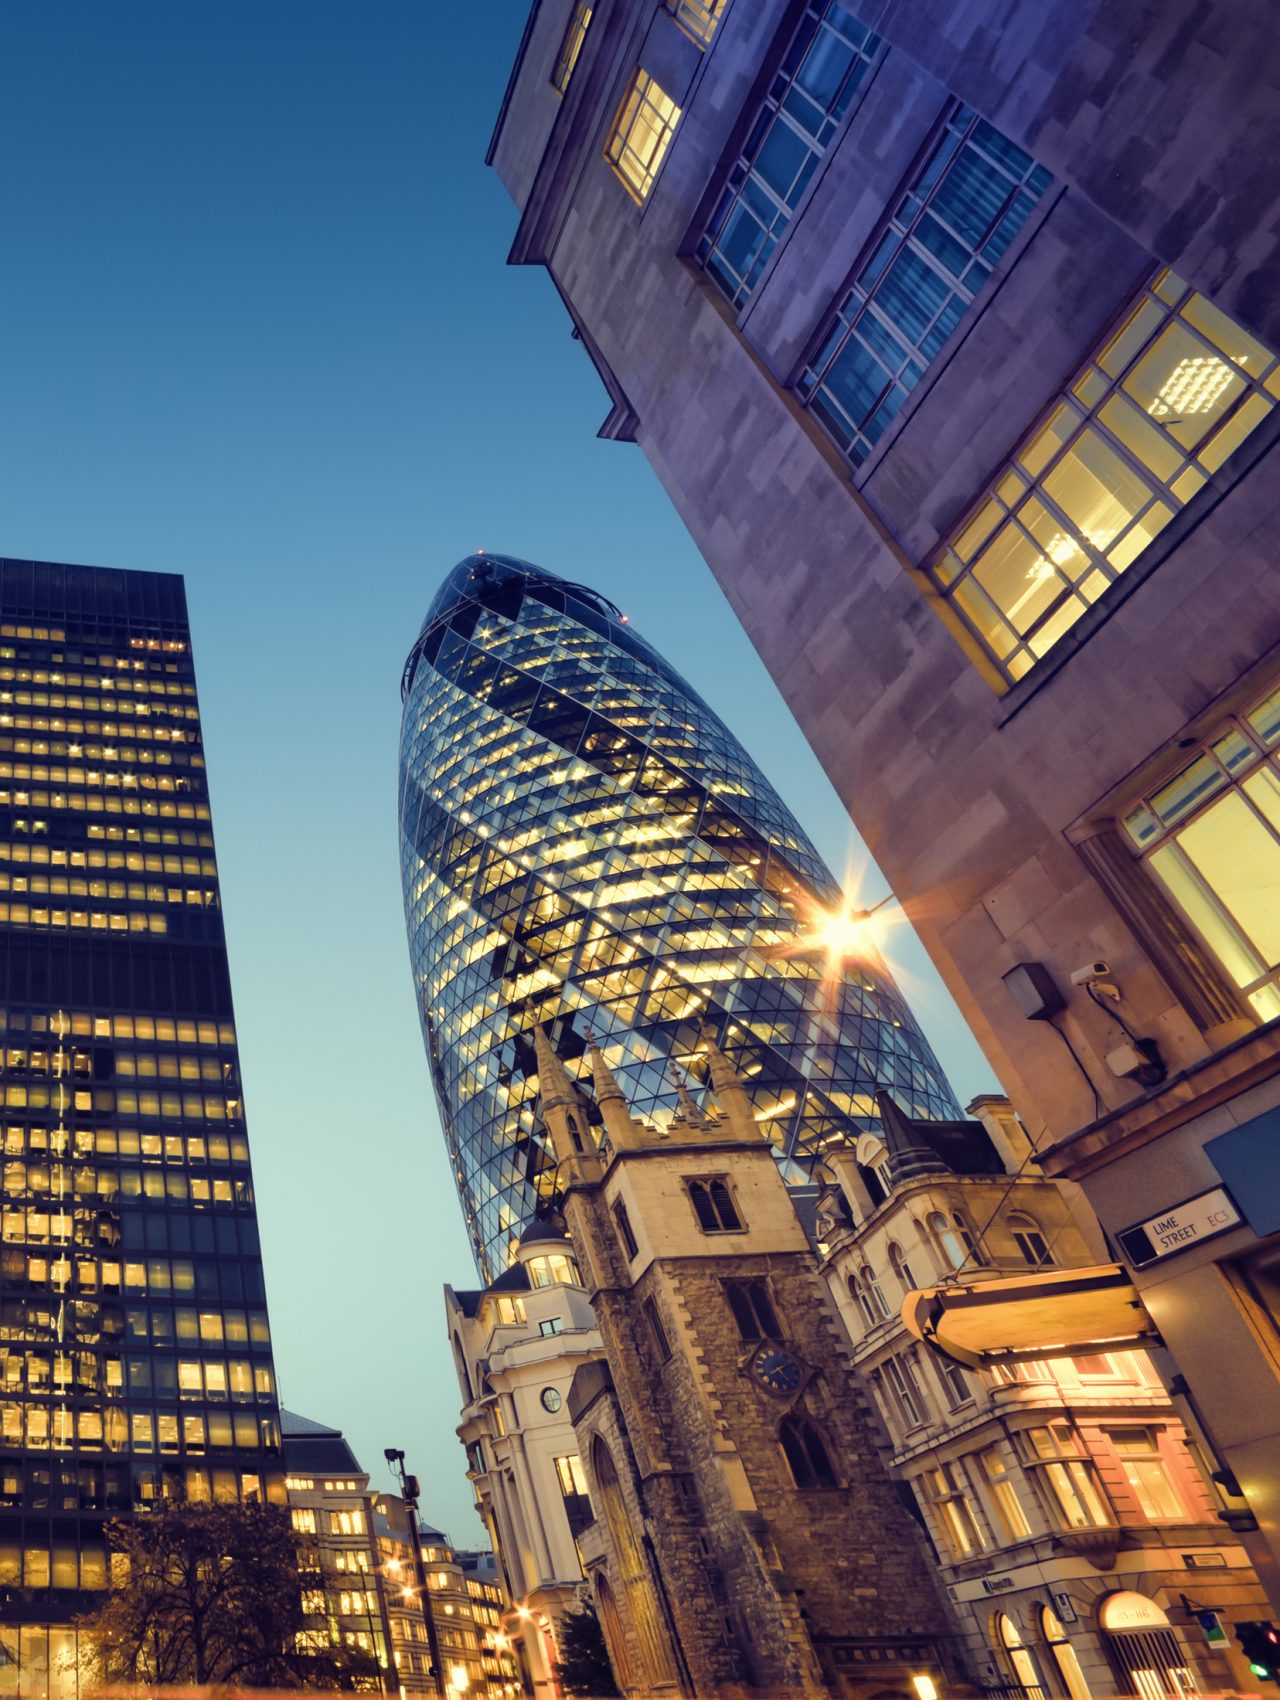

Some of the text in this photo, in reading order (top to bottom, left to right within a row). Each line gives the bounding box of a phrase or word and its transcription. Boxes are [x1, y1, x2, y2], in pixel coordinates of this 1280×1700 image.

[1152, 1216, 1179, 1236] LIME
[1160, 1209, 1230, 1248] STREET EC3
